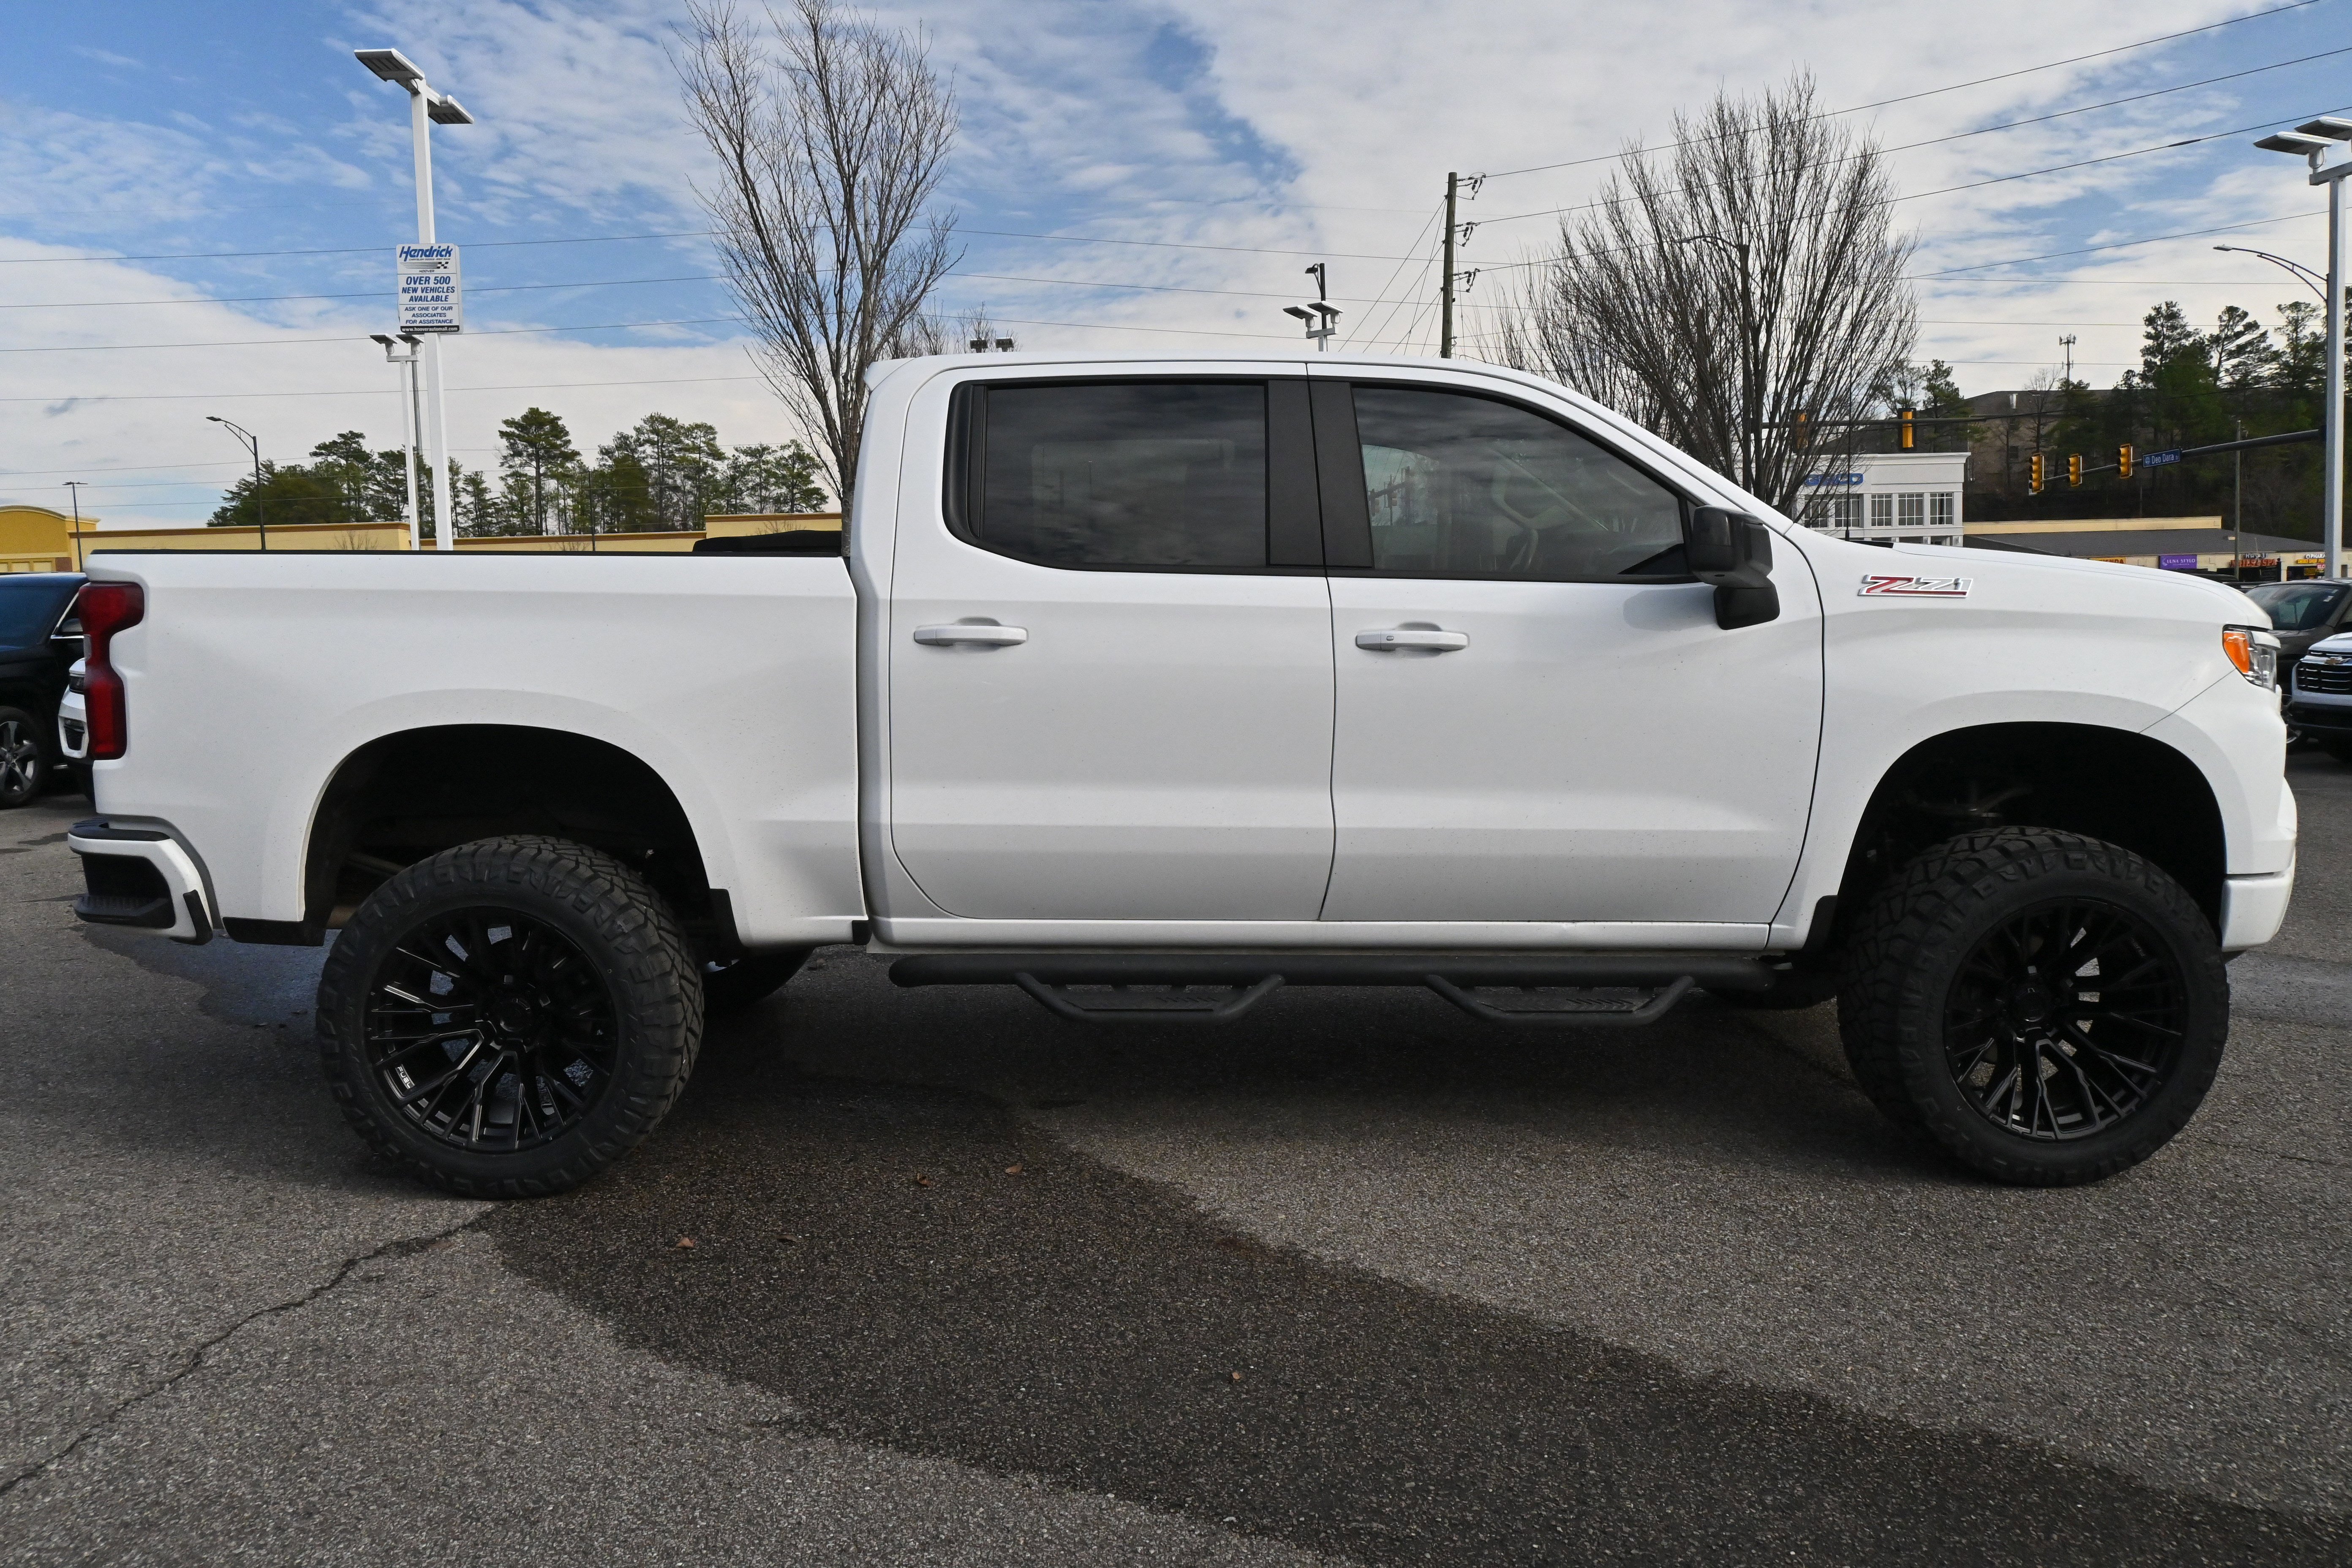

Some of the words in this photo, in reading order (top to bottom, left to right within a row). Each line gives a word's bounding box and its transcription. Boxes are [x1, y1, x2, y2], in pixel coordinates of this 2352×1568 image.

[399, 245, 453, 261] Hendrick
[406, 276, 430, 285] OVER
[433, 276, 451, 285] 500
[2151, 456, 2161, 464] Deo
[2163, 454, 2174, 462] Dara
[1858, 574, 1974, 598] Z71
[397, 1066, 411, 1089] FUEL
